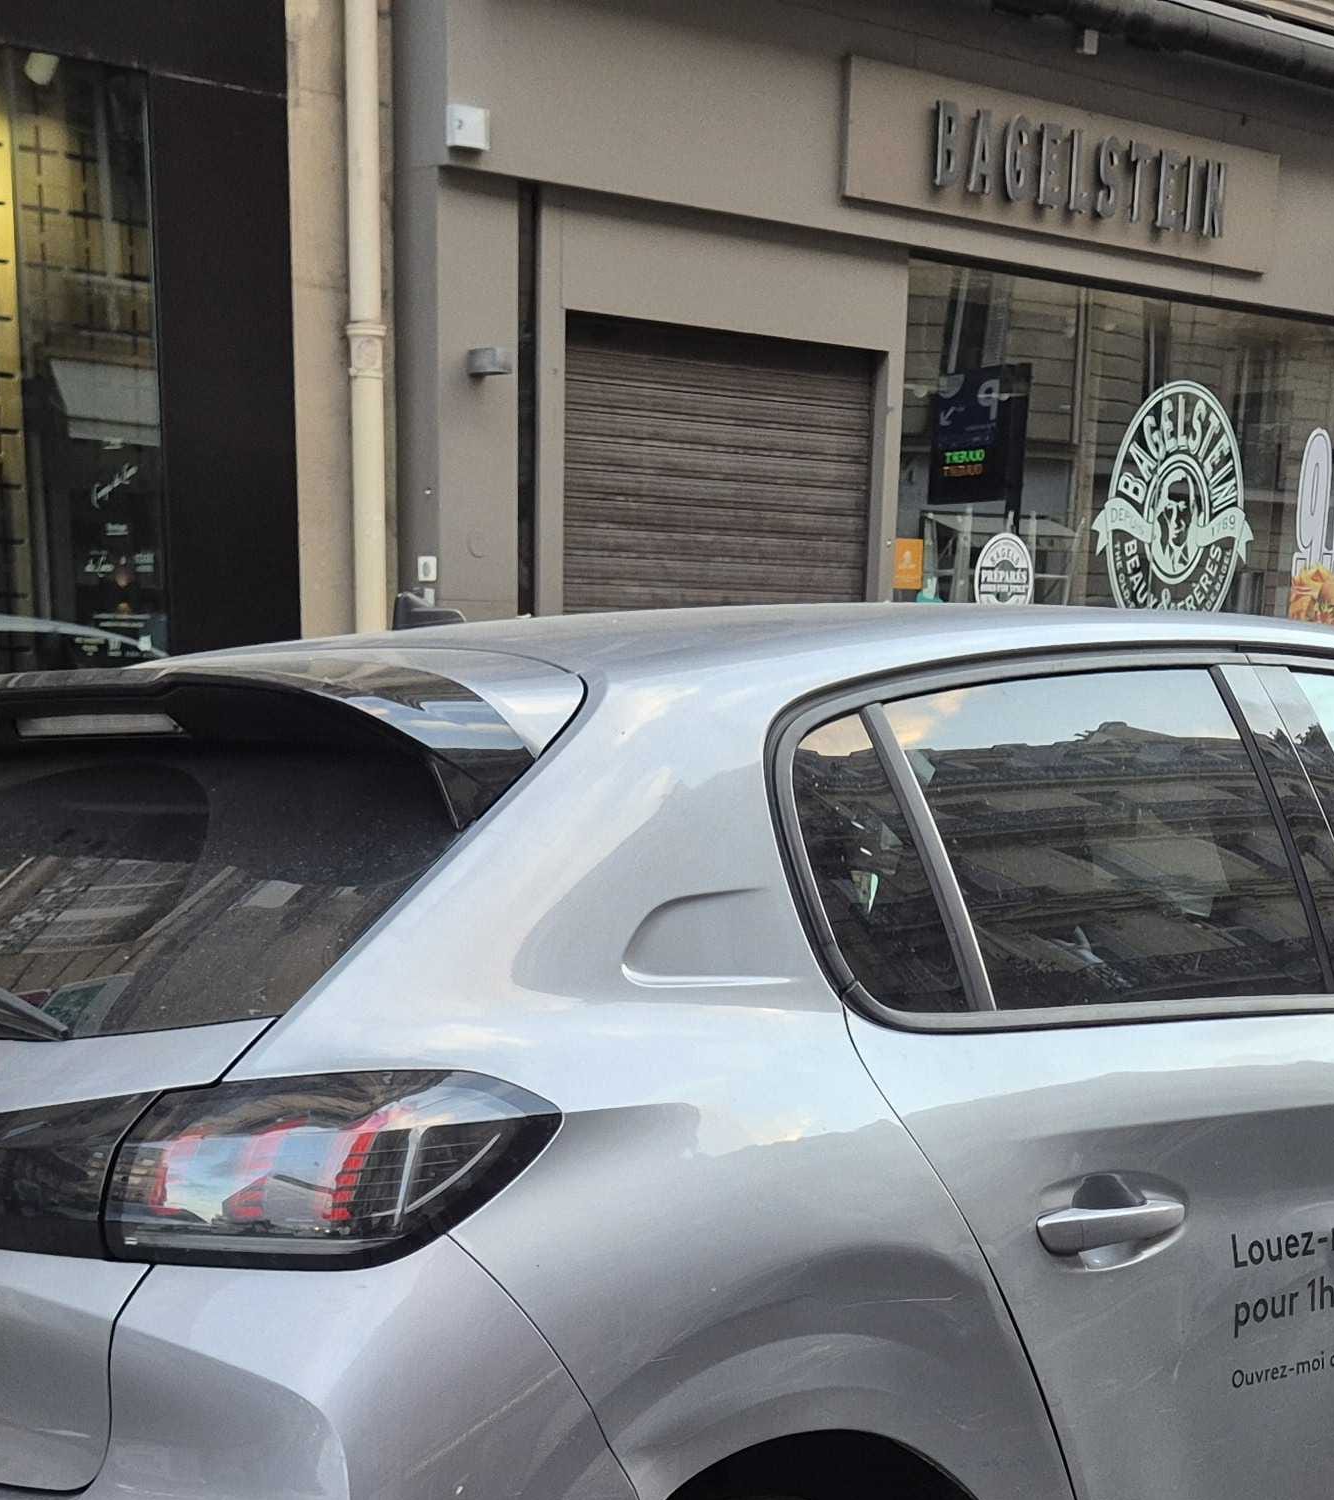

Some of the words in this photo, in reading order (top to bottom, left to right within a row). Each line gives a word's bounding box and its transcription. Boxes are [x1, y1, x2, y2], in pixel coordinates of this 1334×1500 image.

[932, 100, 1228, 239] BAGELSTEIN
[1118, 394, 1238, 514] BAGELSTEIN
[1234, 1290, 1299, 1338] pour
[1307, 1275, 1334, 1312] 1h
[1231, 1351, 1326, 1388] Ouvrez-moi
